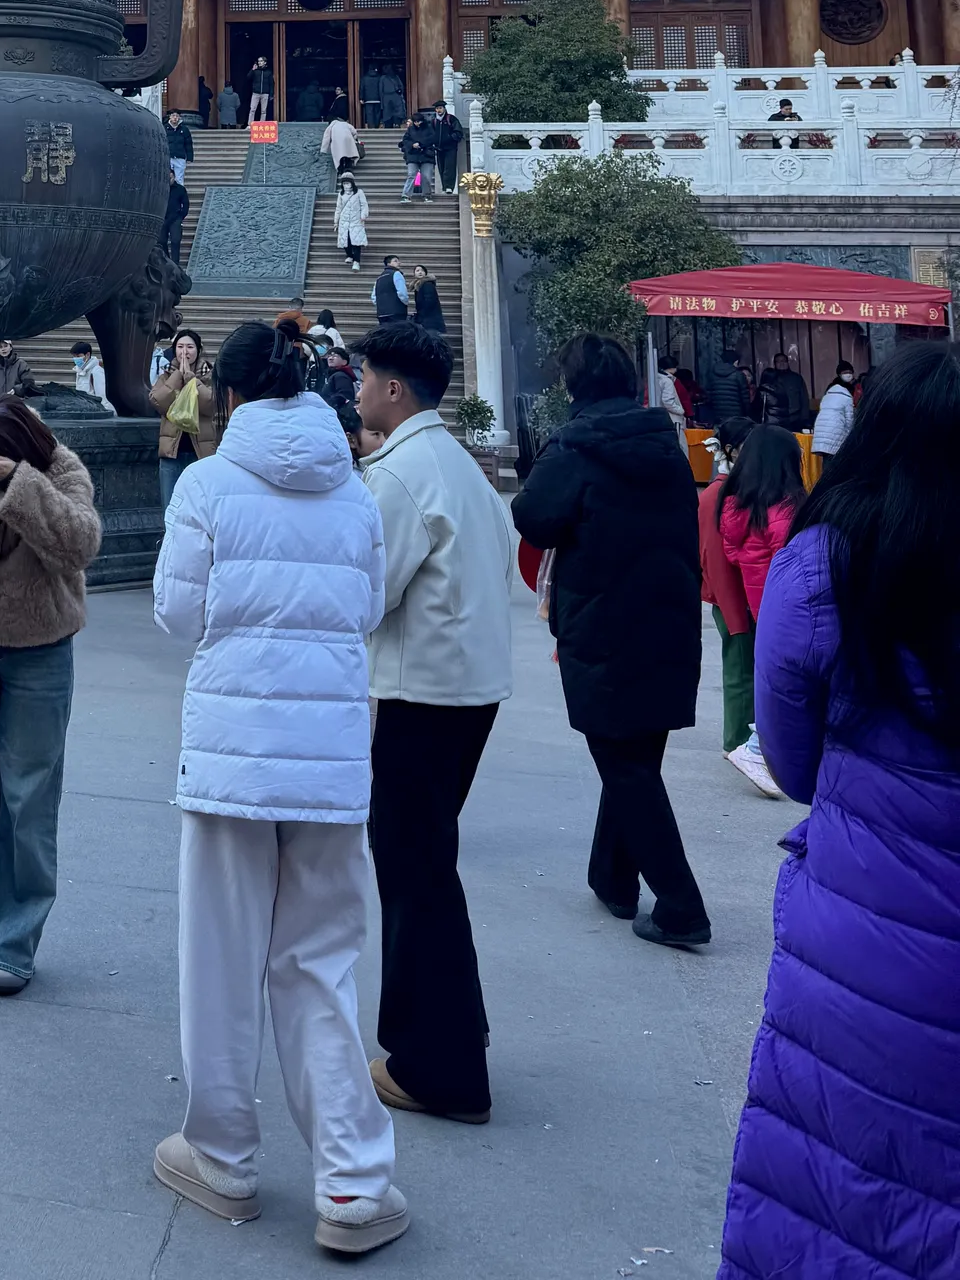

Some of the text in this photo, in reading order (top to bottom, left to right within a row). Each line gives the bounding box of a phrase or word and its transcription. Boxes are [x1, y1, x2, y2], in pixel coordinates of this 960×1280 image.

[669, 296, 908, 318] 请法物 护平安 恭敬心 佑吉祥
